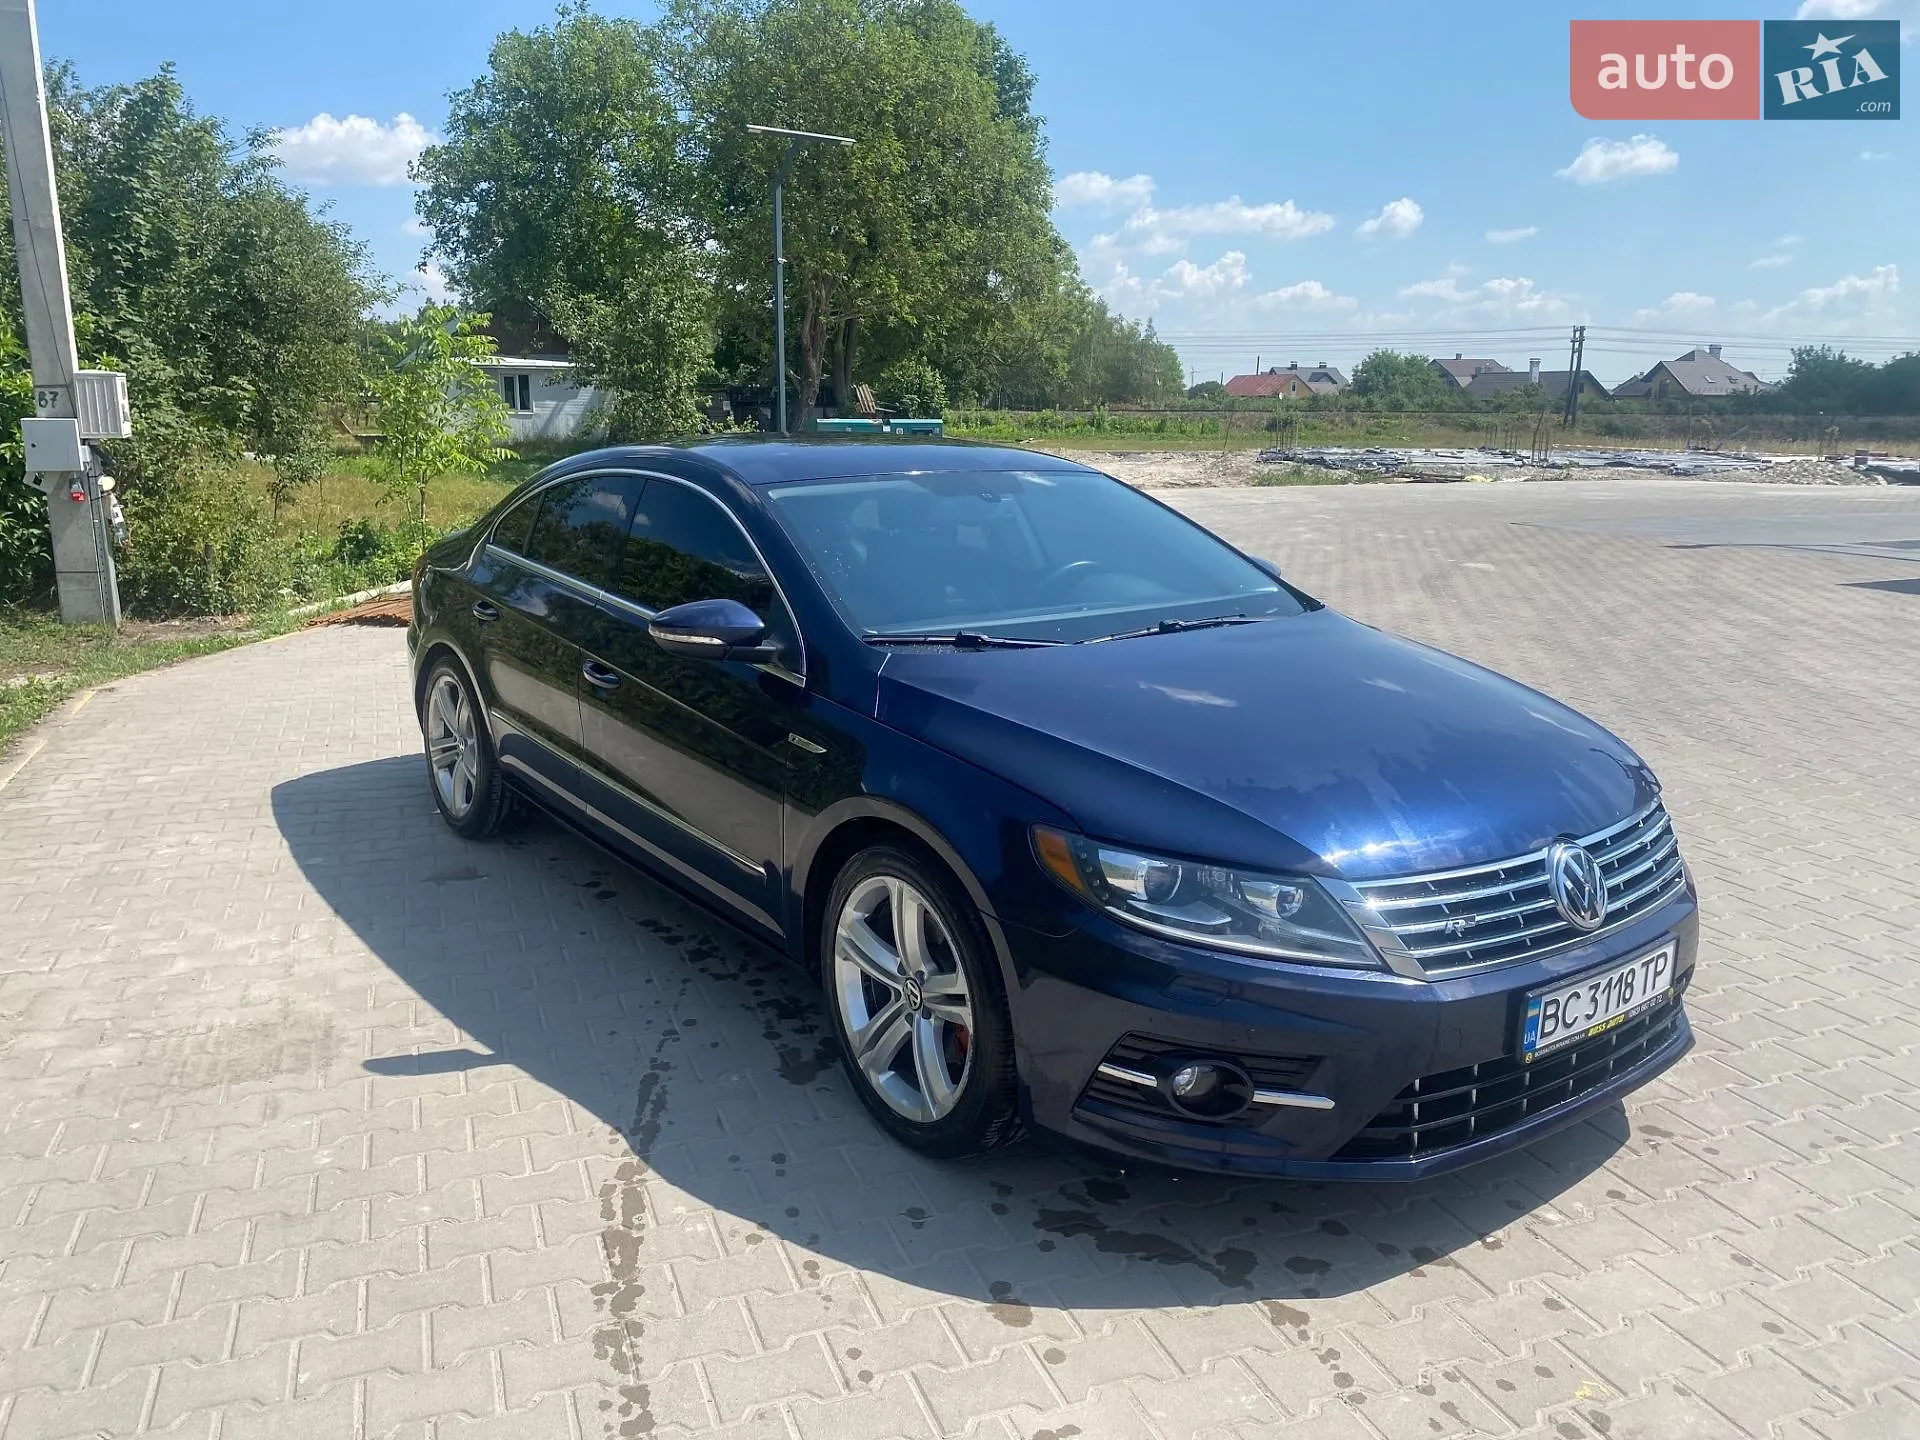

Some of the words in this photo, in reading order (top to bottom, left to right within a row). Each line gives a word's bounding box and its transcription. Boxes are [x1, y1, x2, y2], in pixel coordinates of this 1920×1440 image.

[38, 391, 59, 409] 67
[1540, 990, 1581, 1040] BC
[1585, 967, 1636, 1021] 3118
[1641, 950, 1668, 997] TP
[1524, 1030, 1536, 1045] UA
